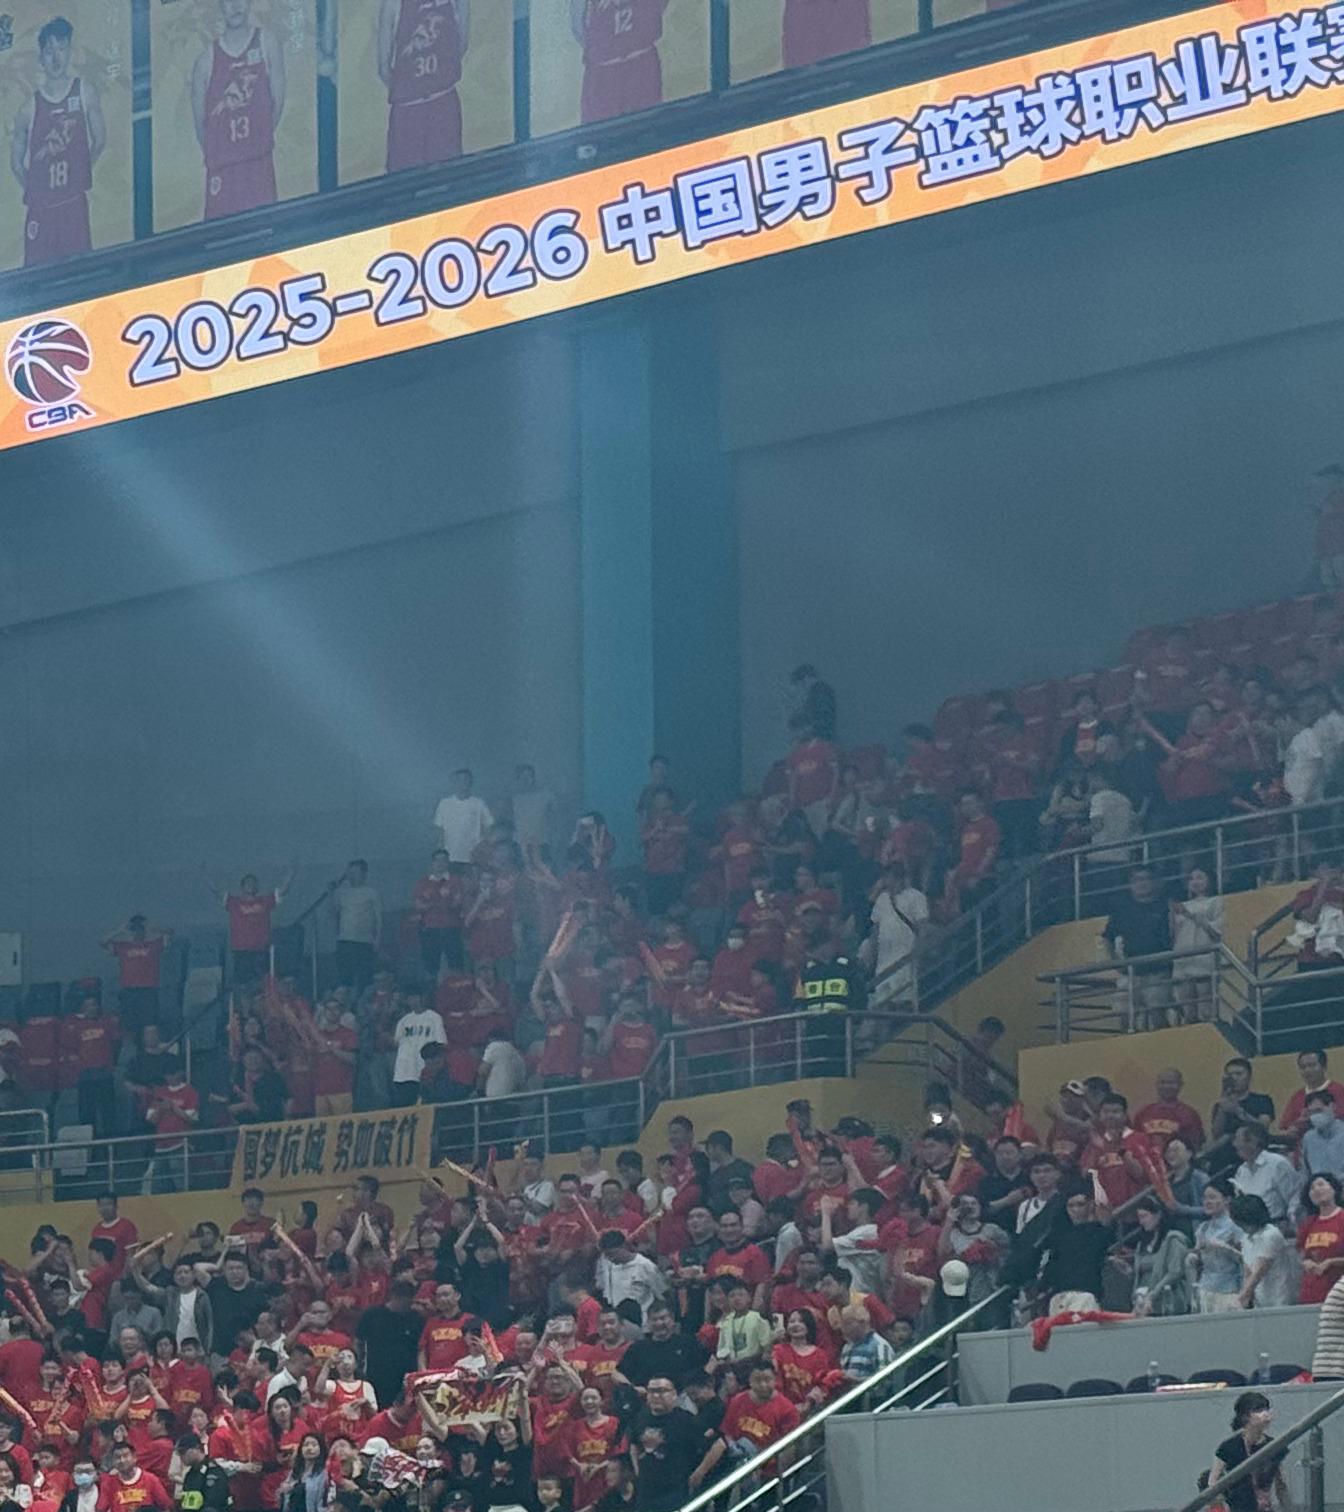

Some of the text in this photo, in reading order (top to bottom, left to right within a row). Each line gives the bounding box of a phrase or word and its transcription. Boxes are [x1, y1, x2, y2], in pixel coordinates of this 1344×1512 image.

[415, 56, 437, 77] 30
[229, 117, 250, 142] 13
[49, 161, 68, 189] 18
[124, 210, 587, 388] 2025-2026
[26, 403, 95, 431] CBA
